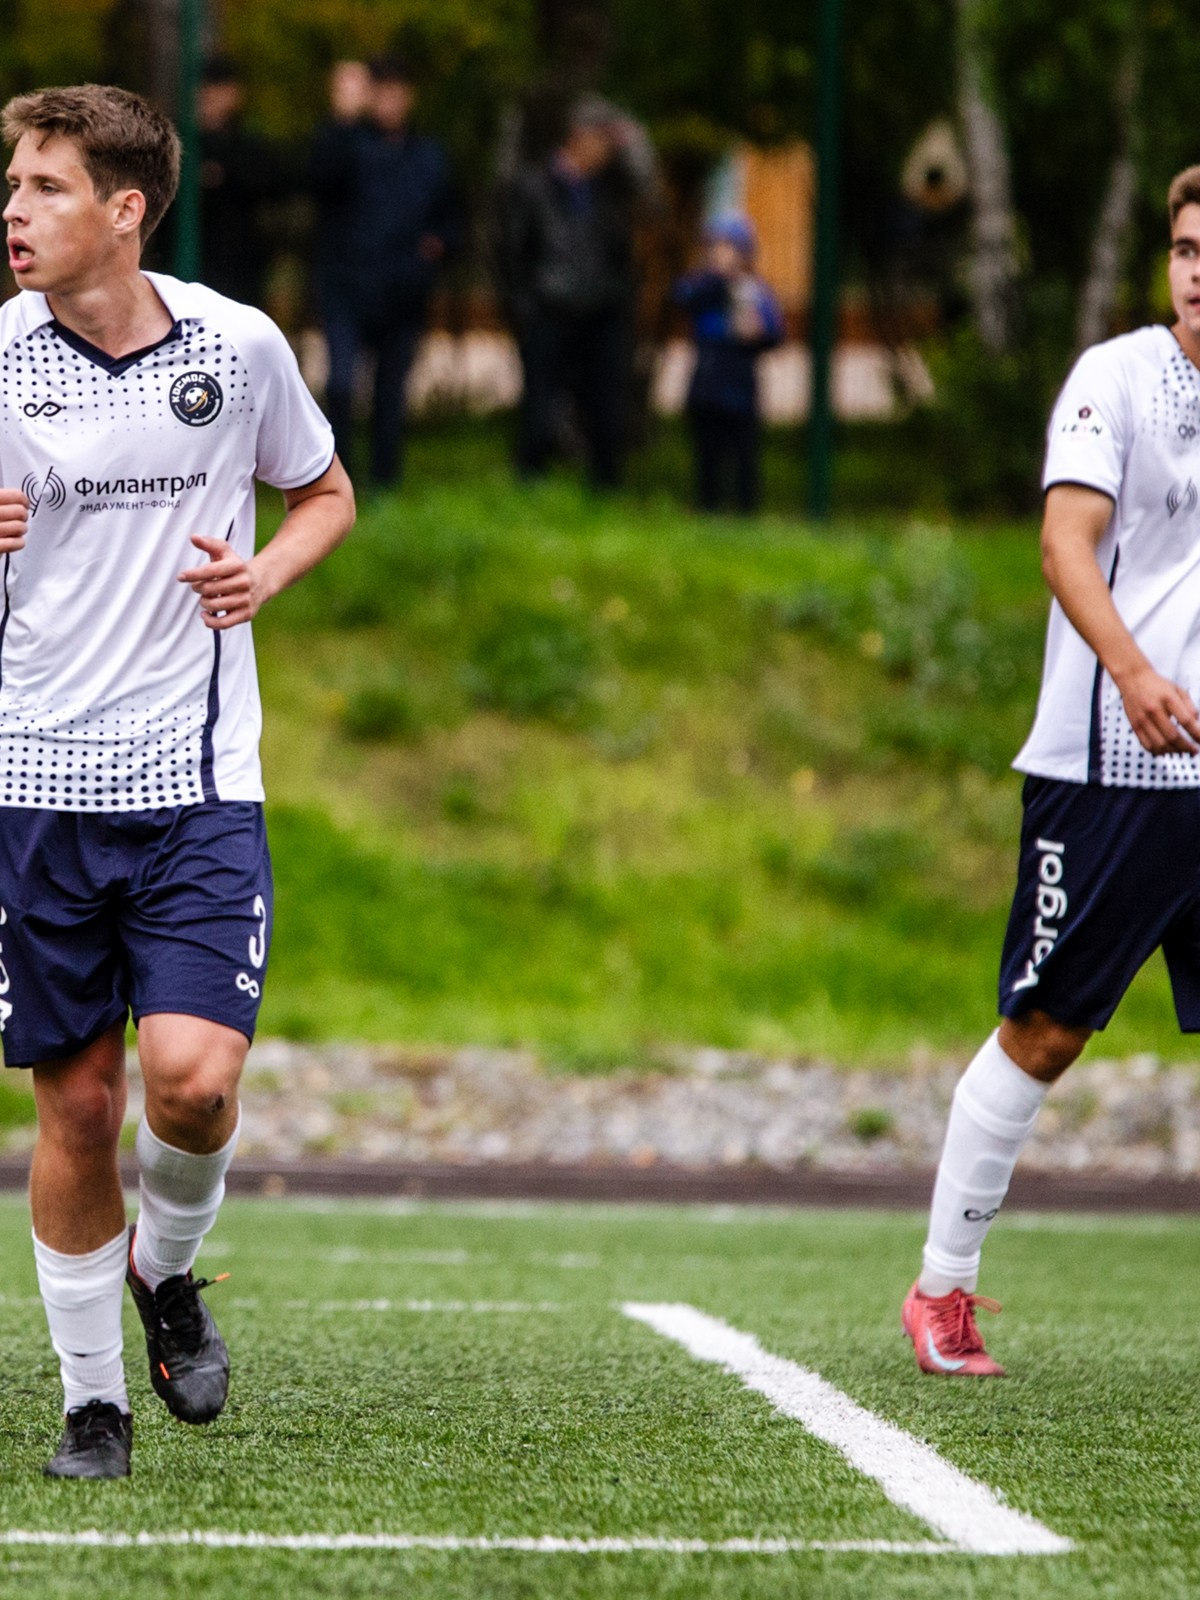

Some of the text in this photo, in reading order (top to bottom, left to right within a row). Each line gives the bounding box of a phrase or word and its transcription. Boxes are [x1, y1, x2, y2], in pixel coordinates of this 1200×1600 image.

[171, 373, 206, 403] КОСМОС
[74, 472, 207, 497] Филантроп
[79, 499, 181, 512] ЭНДАУМЕНТ-ФОНД
